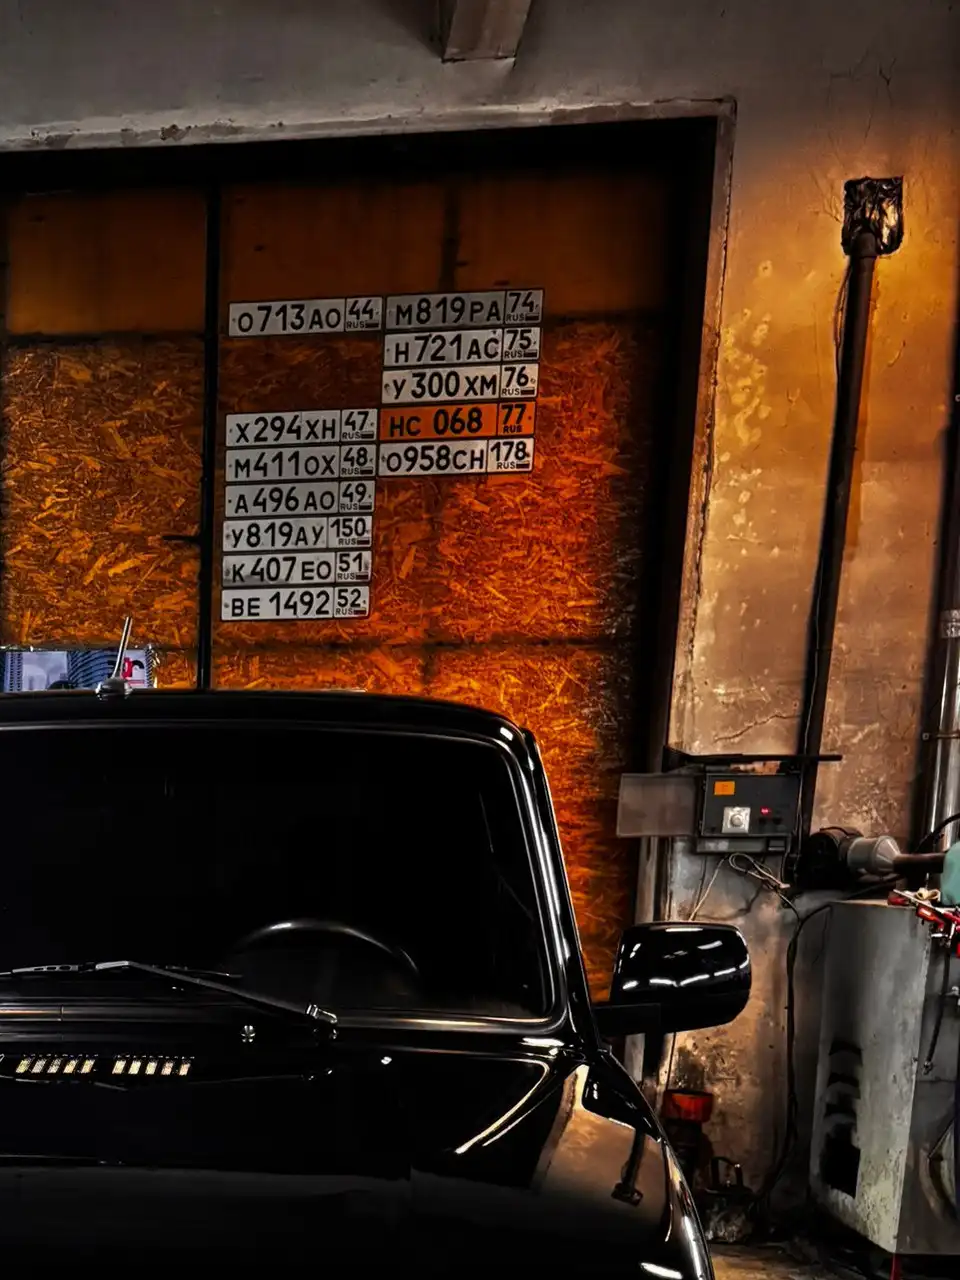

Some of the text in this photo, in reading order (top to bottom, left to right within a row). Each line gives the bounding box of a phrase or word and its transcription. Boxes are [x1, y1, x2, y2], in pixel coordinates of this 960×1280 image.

[348, 299, 374, 320] 44
[509, 292, 534, 313] 74
[346, 320, 365, 329] RUS
[506, 313, 526, 322] RUS
[506, 329, 532, 350] 75
[504, 350, 523, 359] RUS
[505, 366, 529, 387] 76
[502, 387, 520, 396] RUS
[344, 411, 369, 431] 47
[501, 404, 526, 425] 77
[341, 431, 360, 440] RUS
[503, 425, 522, 434] RUS
[343, 447, 368, 466] 48
[490, 441, 527, 461] 178
[341, 467, 360, 475] RUS
[497, 461, 515, 470] RUS
[341, 483, 366, 502] 49
[340, 503, 359, 511] RUS
[330, 518, 366, 537] 150
[338, 537, 356, 546] RUS
[339, 553, 364, 572] 51
[337, 572, 355, 580] RUS
[338, 588, 361, 608] 52
[336, 608, 353, 616] RUS
